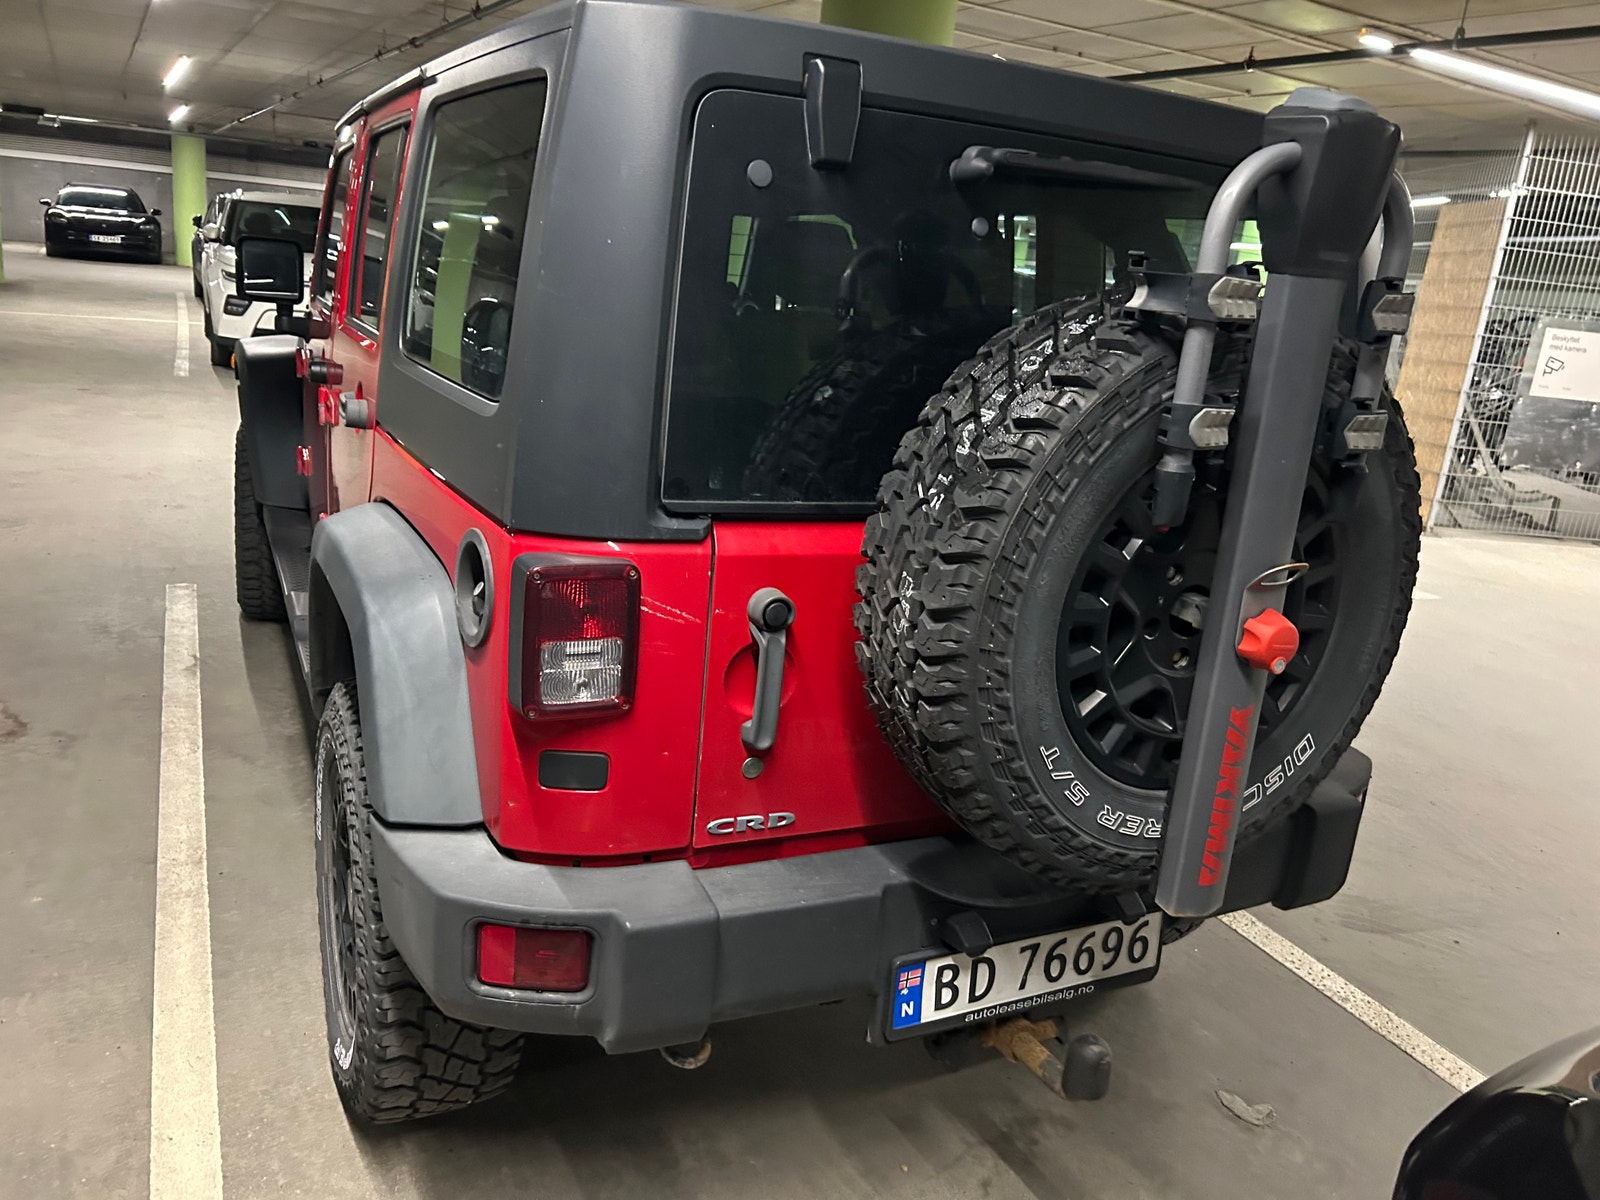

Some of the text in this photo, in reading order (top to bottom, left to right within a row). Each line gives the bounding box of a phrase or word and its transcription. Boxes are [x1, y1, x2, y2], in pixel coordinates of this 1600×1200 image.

[1552, 334, 1580, 343] Beskyttet
[1039, 745, 1090, 807] S/T
[1198, 704, 1255, 886] YAKIMA
[706, 811, 795, 834] CRD
[934, 919, 1149, 1012] BD 76696
[901, 1001, 914, 1018] N
[964, 983, 1095, 1022] autoleasebilsalg.no
